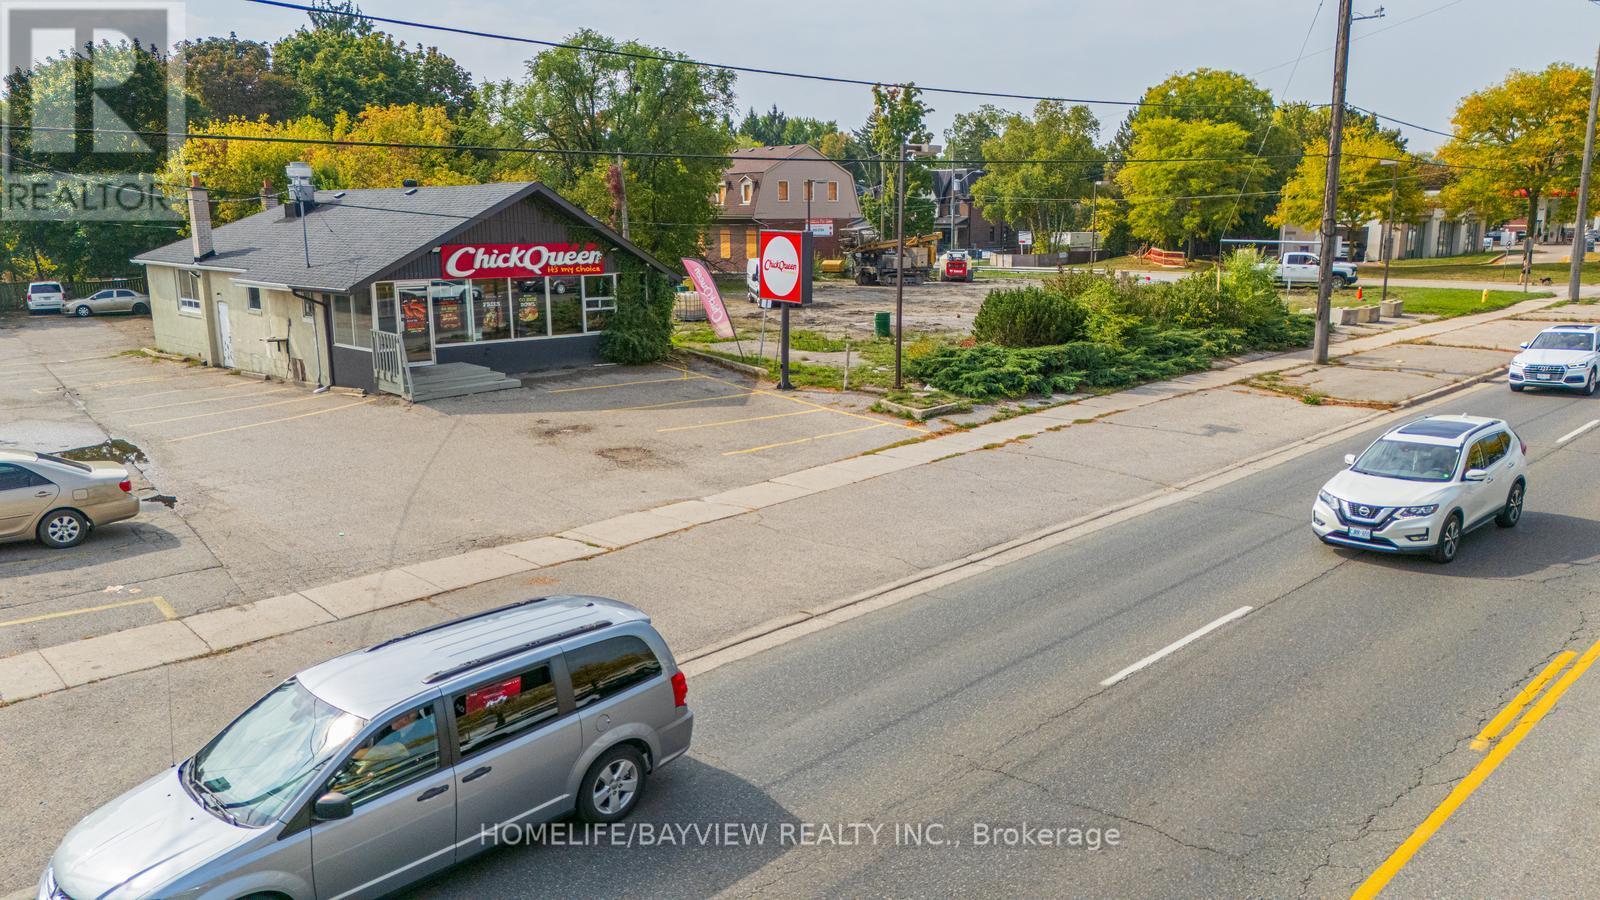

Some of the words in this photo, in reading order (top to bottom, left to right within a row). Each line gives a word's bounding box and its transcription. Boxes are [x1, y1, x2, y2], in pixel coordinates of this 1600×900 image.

[445, 245, 602, 277] ChickQueen
[764, 259, 797, 272] ChickQueen
[560, 266, 574, 274] my
[575, 264, 601, 273] choice
